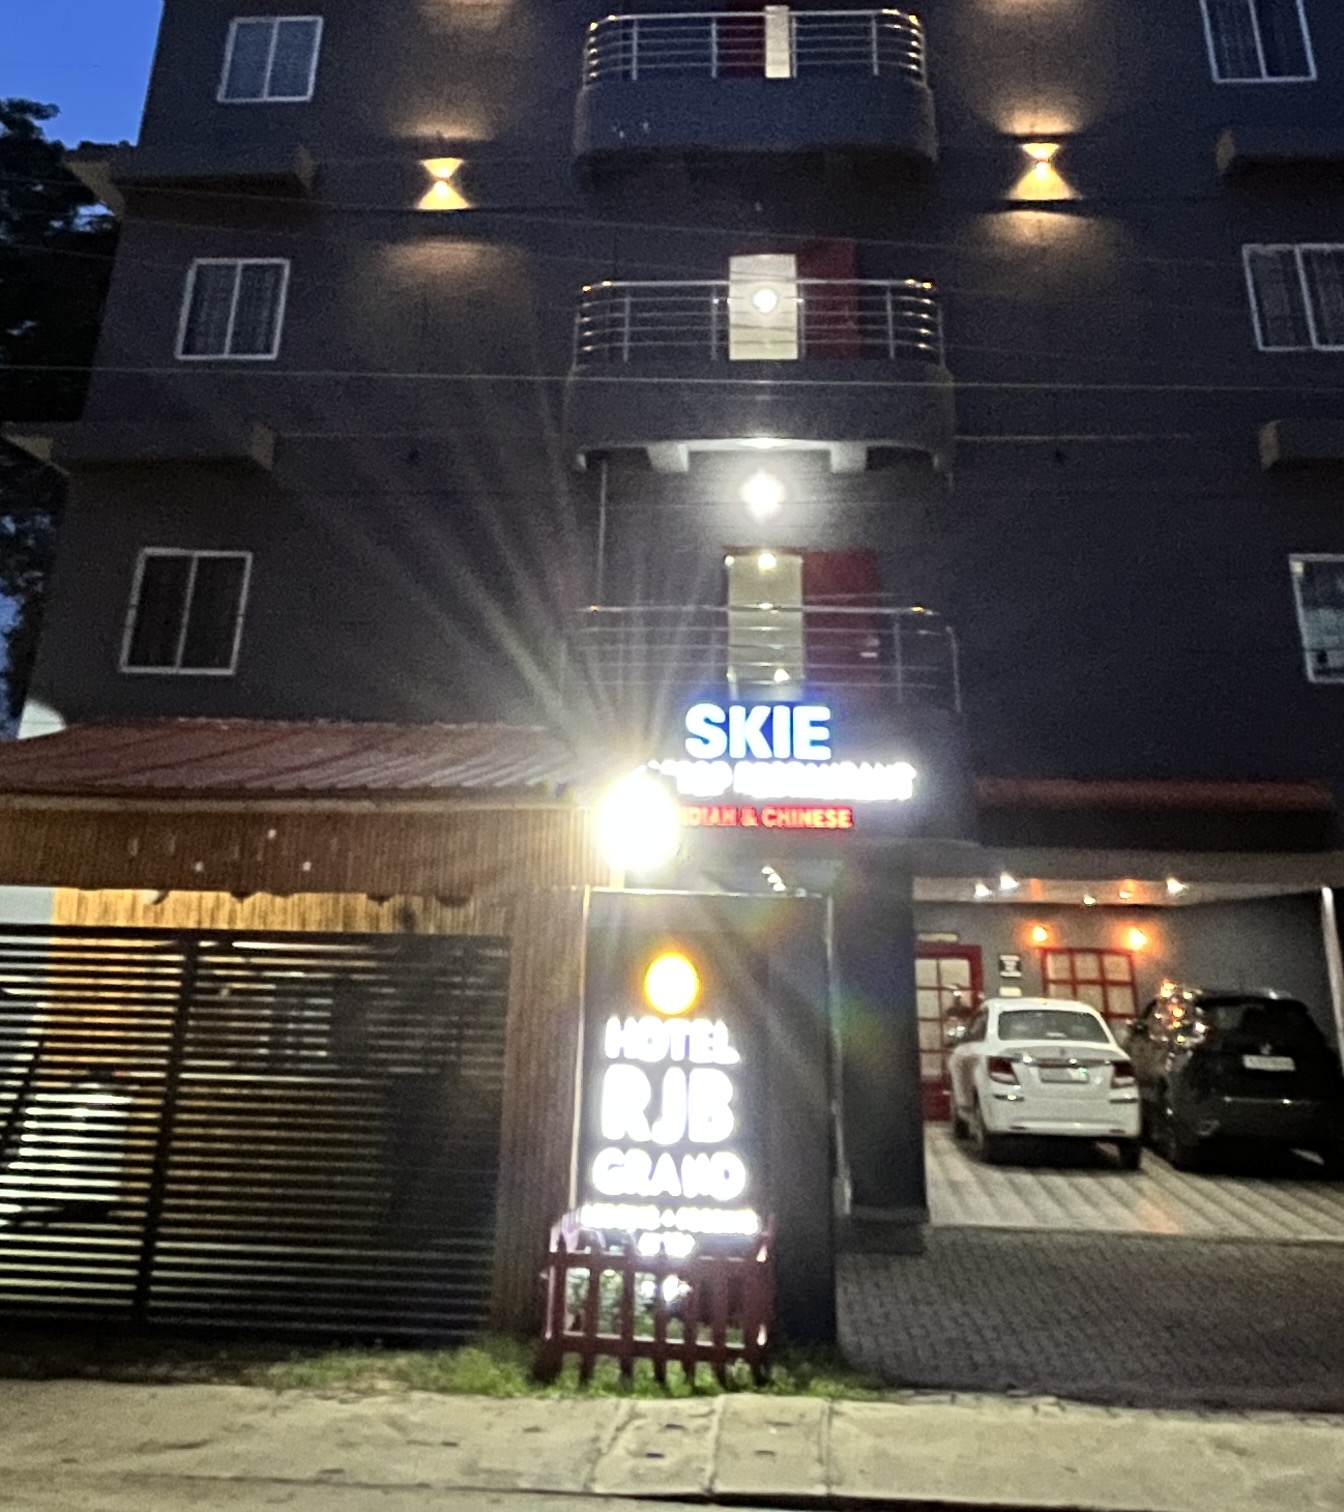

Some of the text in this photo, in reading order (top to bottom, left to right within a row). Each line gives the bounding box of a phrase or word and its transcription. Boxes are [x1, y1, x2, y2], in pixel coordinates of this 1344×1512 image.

[685, 703, 832, 761] SKIE
[676, 805, 737, 826] DIAN
[761, 806, 854, 829] CHINESE
[604, 1016, 741, 1065] HOTEL
[601, 1063, 735, 1145] RJB
[592, 1147, 747, 1201] GRAND
